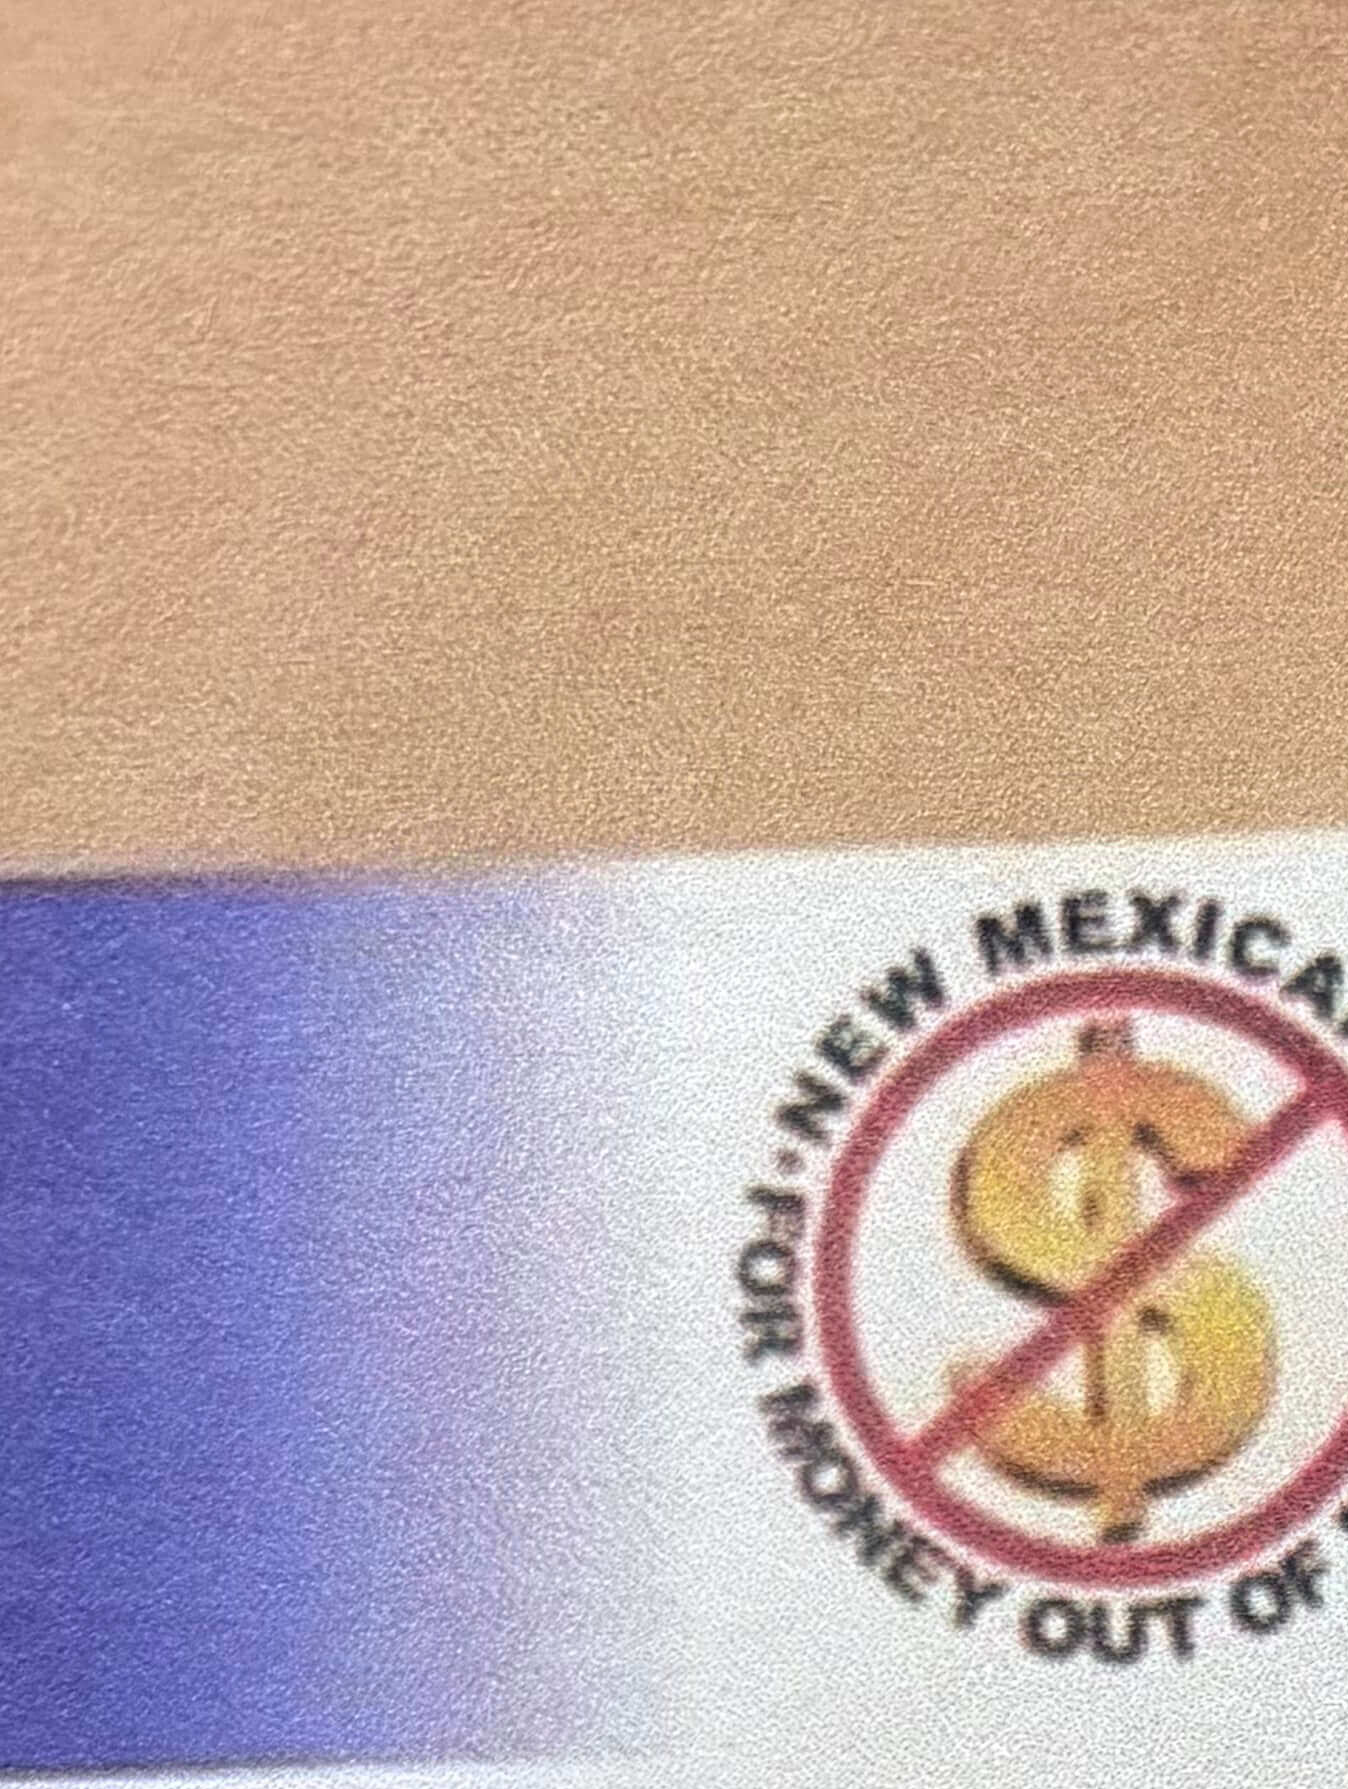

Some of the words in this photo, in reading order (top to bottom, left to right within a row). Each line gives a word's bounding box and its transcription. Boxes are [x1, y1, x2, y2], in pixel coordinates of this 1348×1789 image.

[772, 945, 948, 1142] NEW
[738, 1183, 804, 1365] FOR
[759, 1383, 1009, 1632] MONEY
[1228, 1540, 1332, 1636] OF
[1019, 1595, 1207, 1665] OUT
